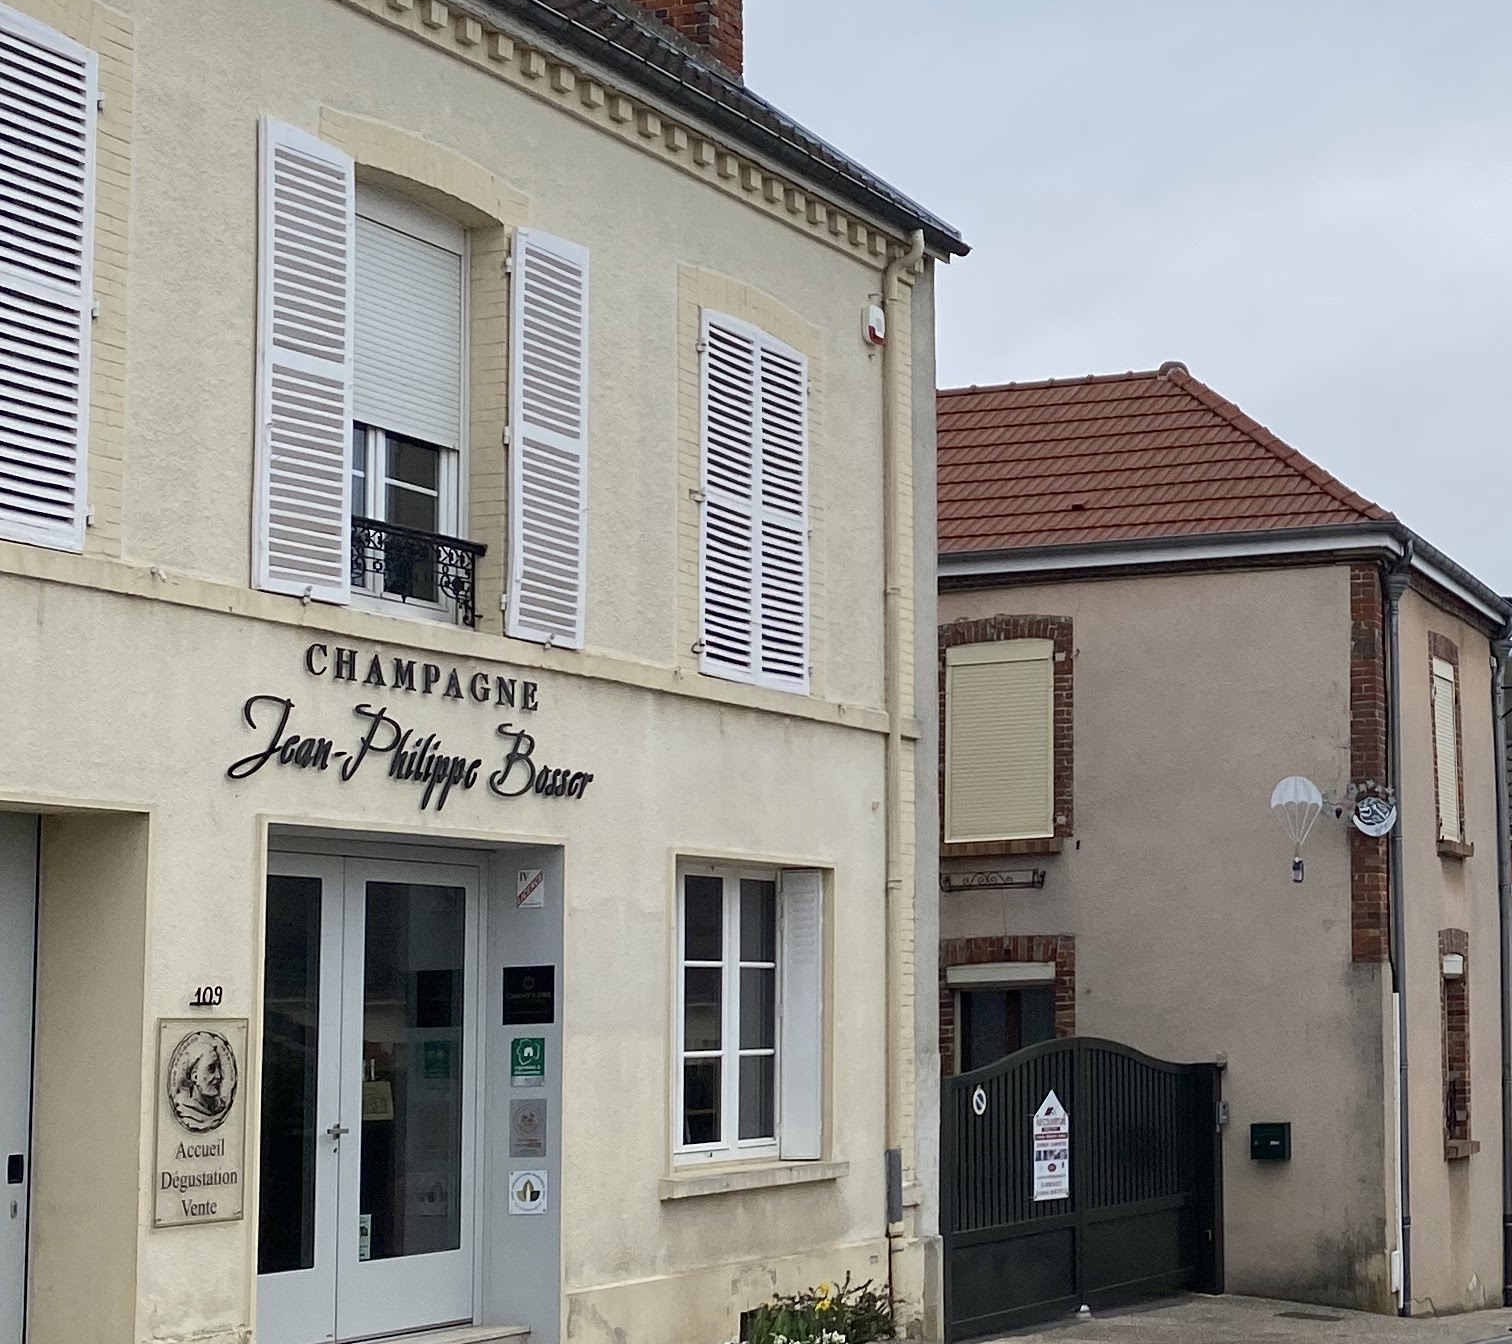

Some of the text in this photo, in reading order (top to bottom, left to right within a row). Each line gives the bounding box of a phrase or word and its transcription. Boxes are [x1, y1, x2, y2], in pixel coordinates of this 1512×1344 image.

[306, 643, 539, 712] CHAMPAGNE
[225, 694, 482, 811] Jean-Philippe
[190, 985, 223, 1007] 109
[175, 1138, 225, 1160] Accueil
[160, 1167, 238, 1193] Dégustation
[181, 1198, 218, 1217] Vente
